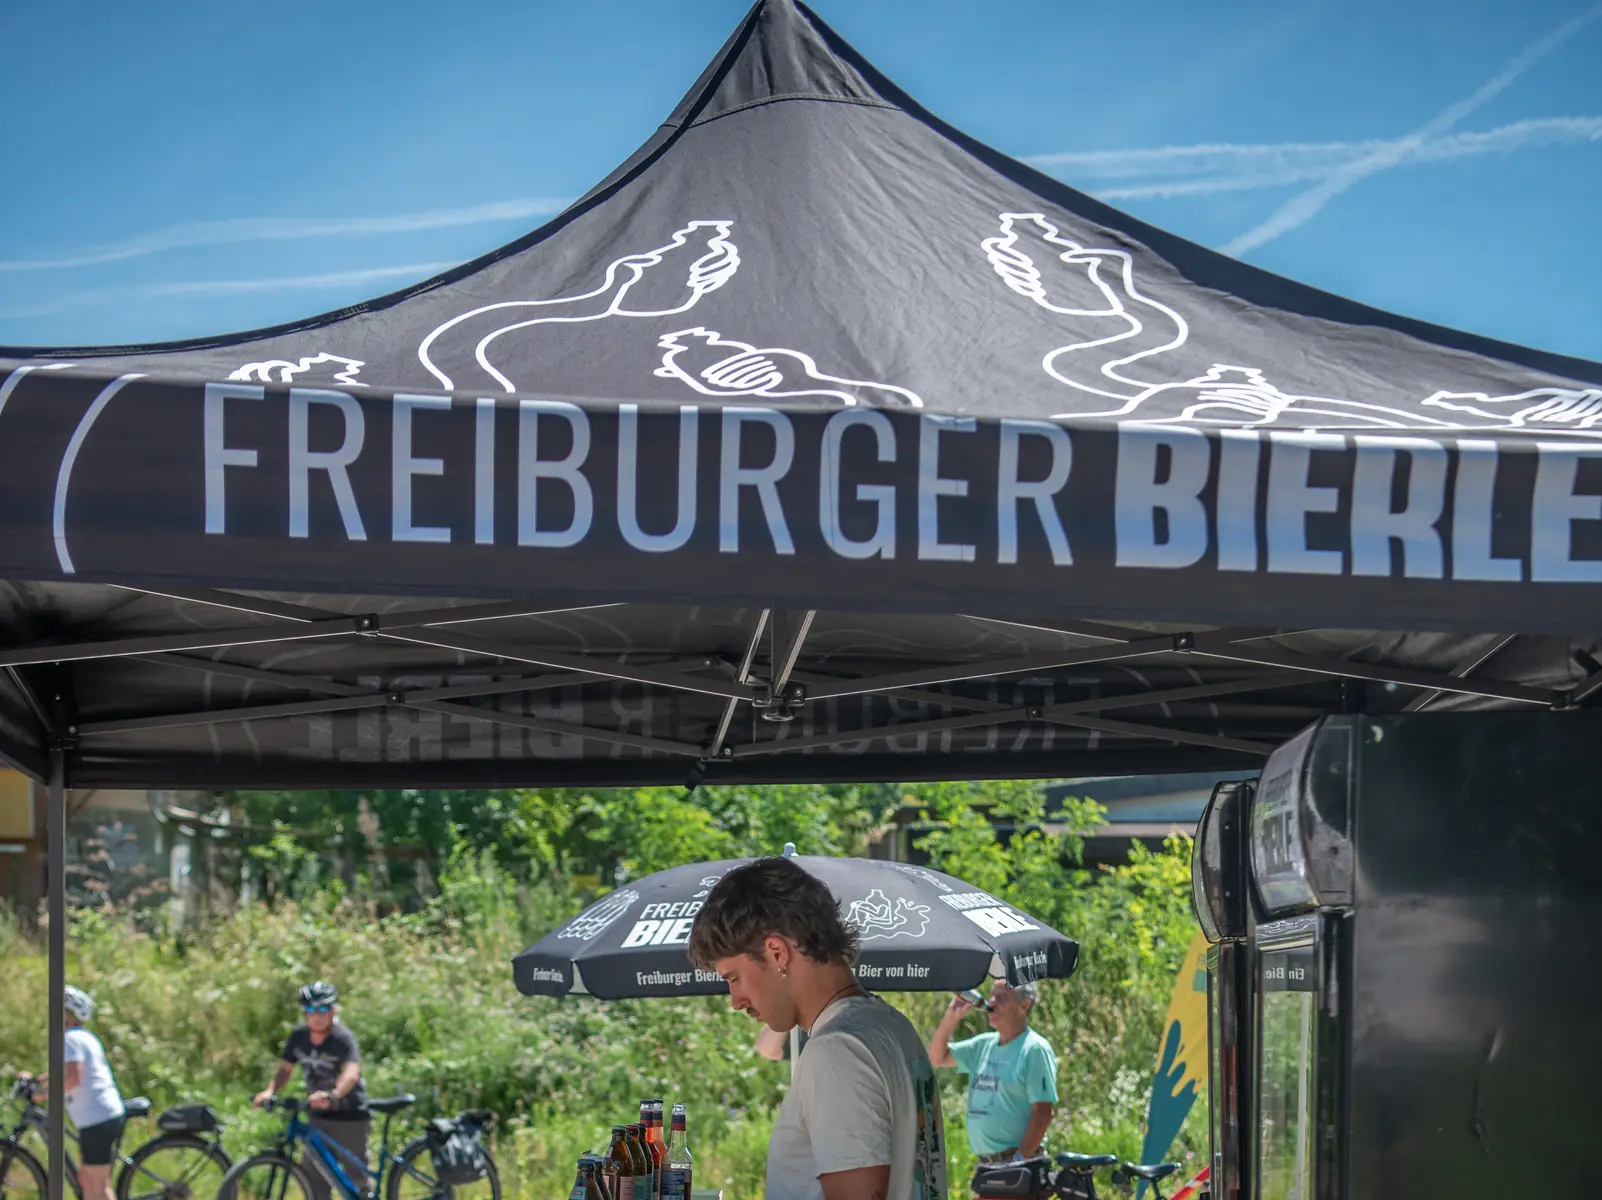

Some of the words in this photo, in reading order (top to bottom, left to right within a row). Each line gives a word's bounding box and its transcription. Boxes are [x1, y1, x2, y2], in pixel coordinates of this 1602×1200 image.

[204, 384, 1074, 567] FREIBURGER
[1114, 420, 1602, 582] BIERLE
[640, 901, 704, 919] FREIB
[620, 918, 693, 948] BIE
[636, 970, 692, 986] Freiburger
[859, 964, 882, 978] Bier
[885, 966, 904, 978] von
[907, 963, 930, 978] hier
